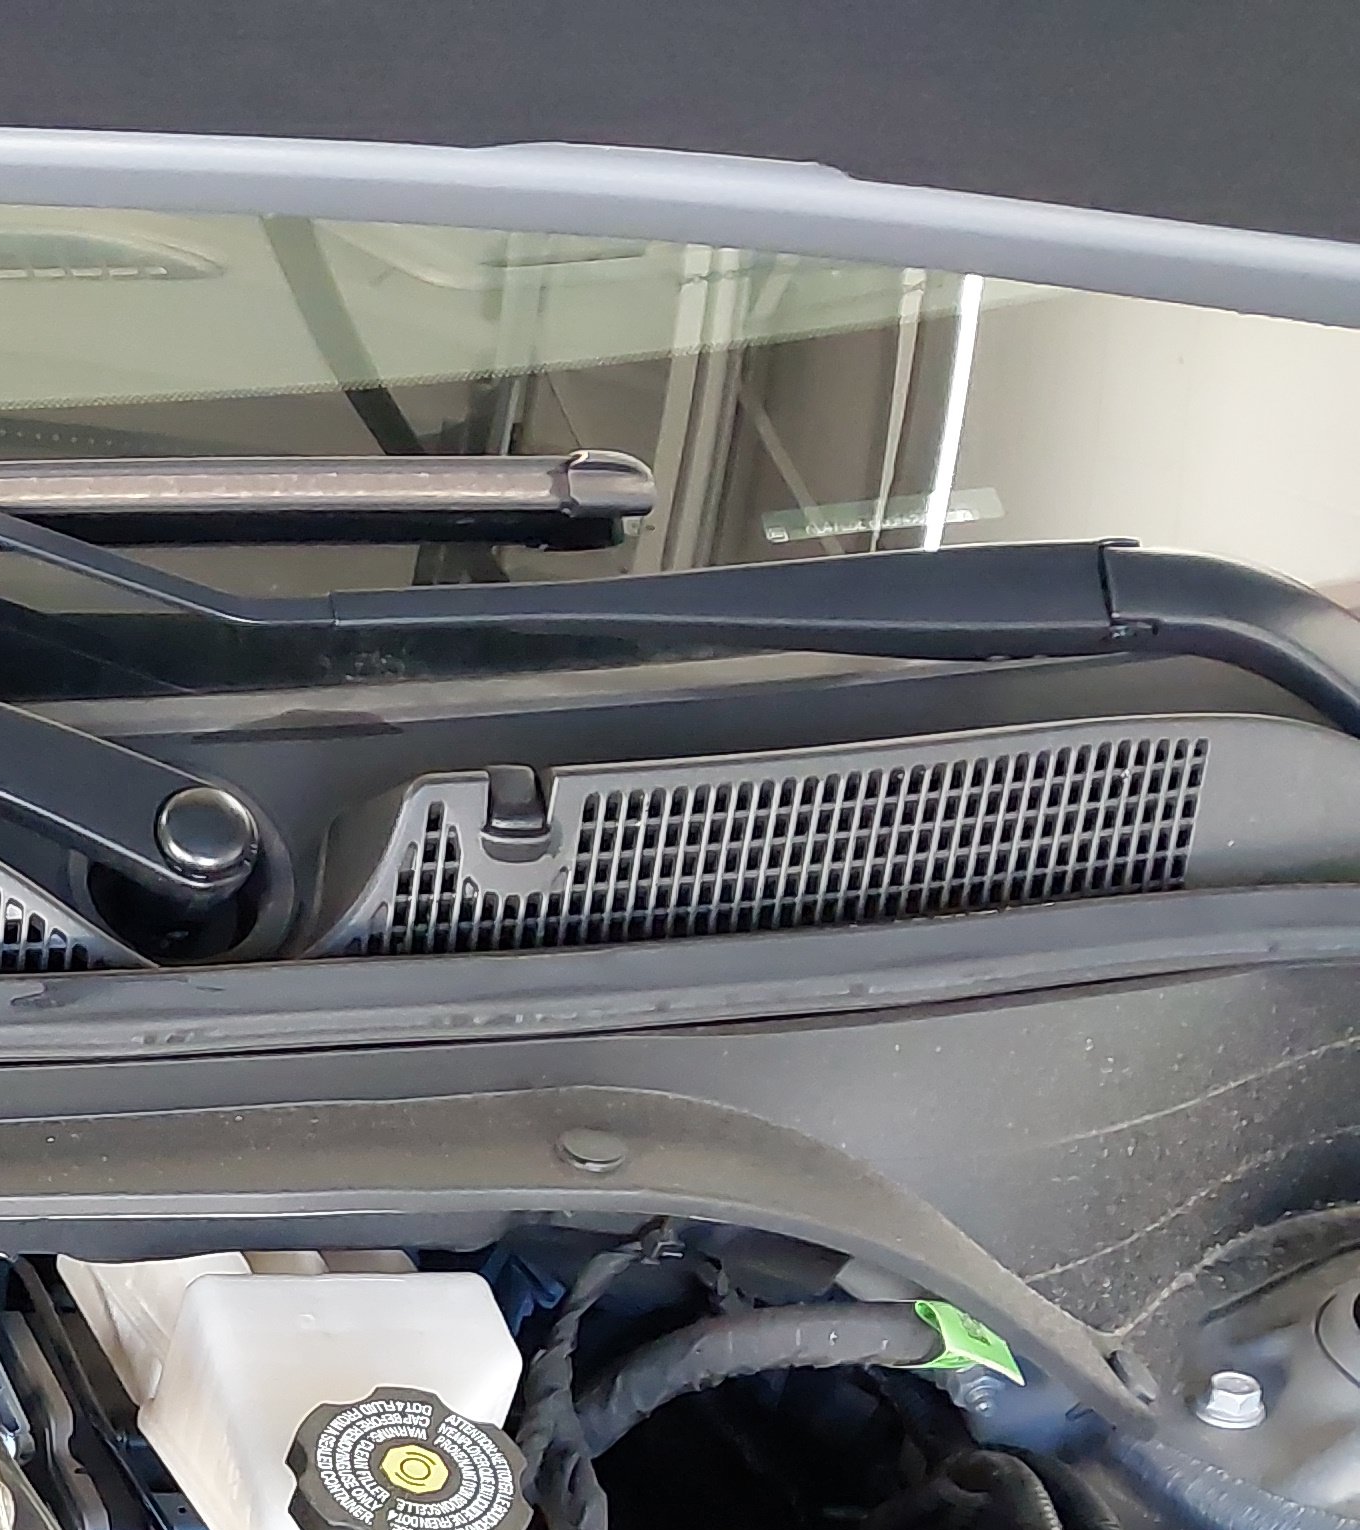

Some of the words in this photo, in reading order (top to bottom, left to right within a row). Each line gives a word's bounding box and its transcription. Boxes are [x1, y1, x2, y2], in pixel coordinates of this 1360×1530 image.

[358, 1400, 396, 1415] FLUID
[403, 1401, 432, 1416] DOT
[328, 1407, 364, 1431] FROM
[355, 1413, 403, 1432] BEFORE
[401, 1413, 430, 1428] CAP
[316, 1432, 336, 1469] SEALED
[353, 1437, 376, 1469] CLEAN
[337, 1469, 359, 1488] USE
[355, 1470, 391, 1502] FILLER
[348, 1487, 383, 1512] ONLY
[394, 1511, 417, 1527] DOT
